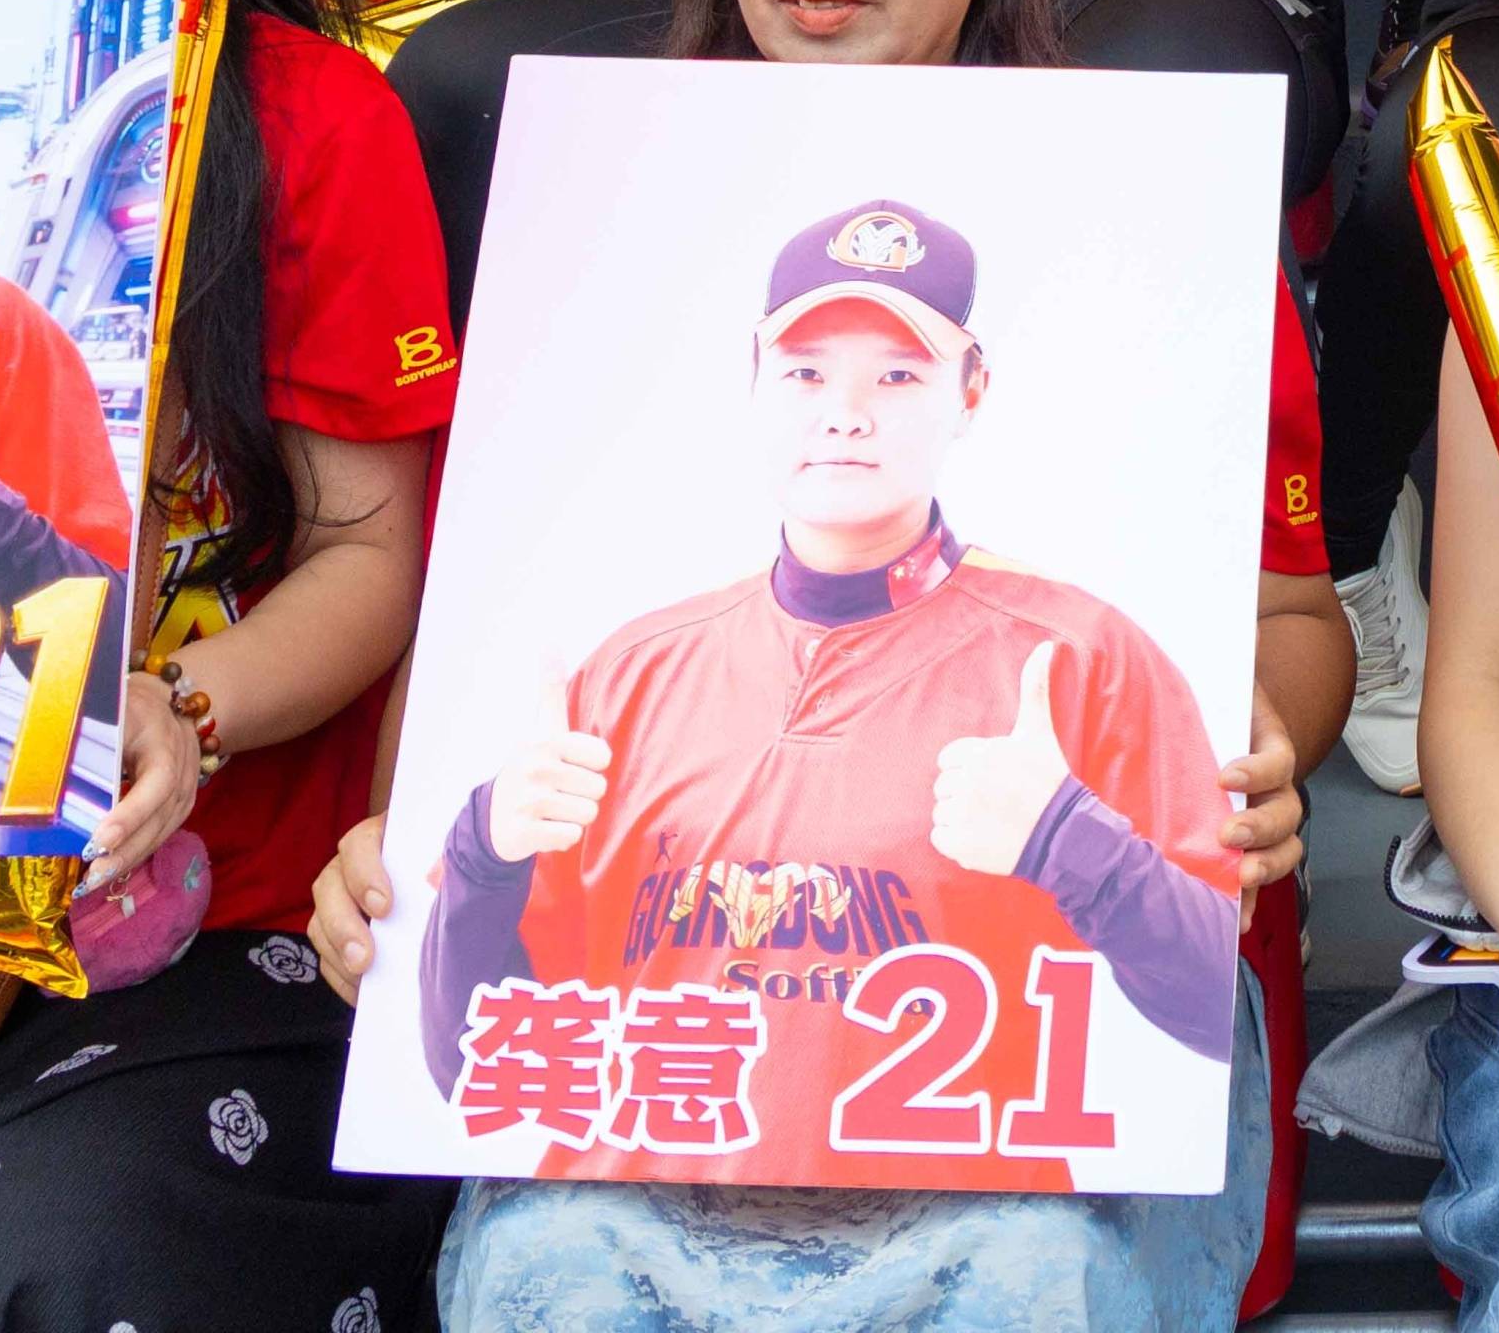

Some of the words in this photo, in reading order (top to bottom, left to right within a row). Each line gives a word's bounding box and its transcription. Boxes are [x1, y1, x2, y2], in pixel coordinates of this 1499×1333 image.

[395, 357, 458, 388] BODYWRAP
[449, 977, 768, 1154] 龚意
[828, 943, 1118, 1159] 21
